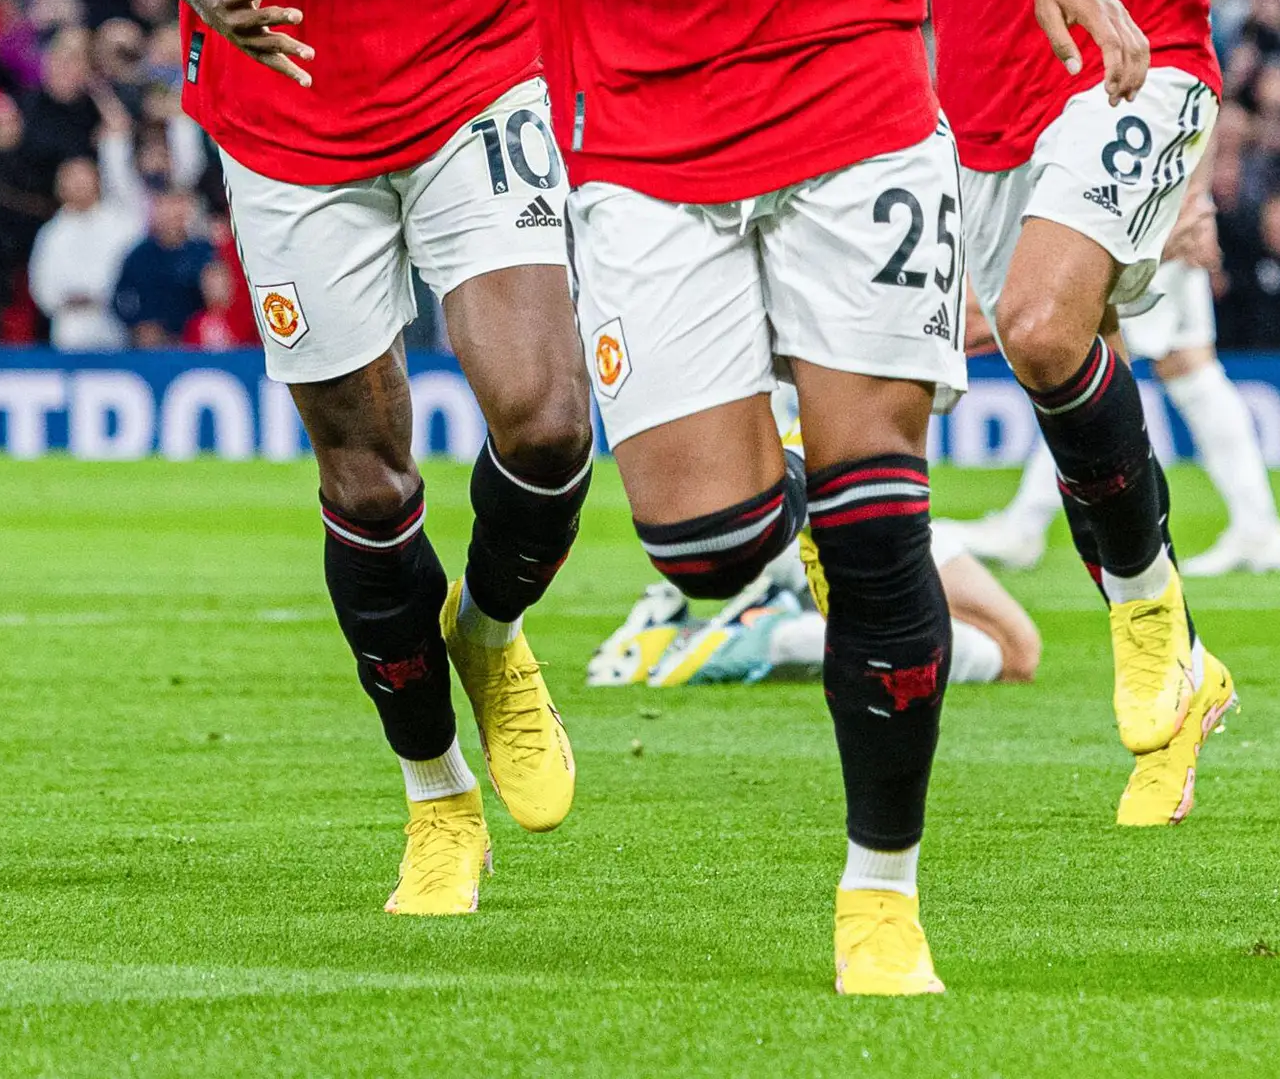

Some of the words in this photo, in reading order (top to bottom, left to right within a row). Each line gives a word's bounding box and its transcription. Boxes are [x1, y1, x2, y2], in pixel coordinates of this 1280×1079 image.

[471, 109, 561, 196] 10
[1101, 115, 1153, 186] 8
[515, 215, 562, 229] adidas
[1083, 190, 1123, 218] adidas
[871, 187, 956, 295] 25
